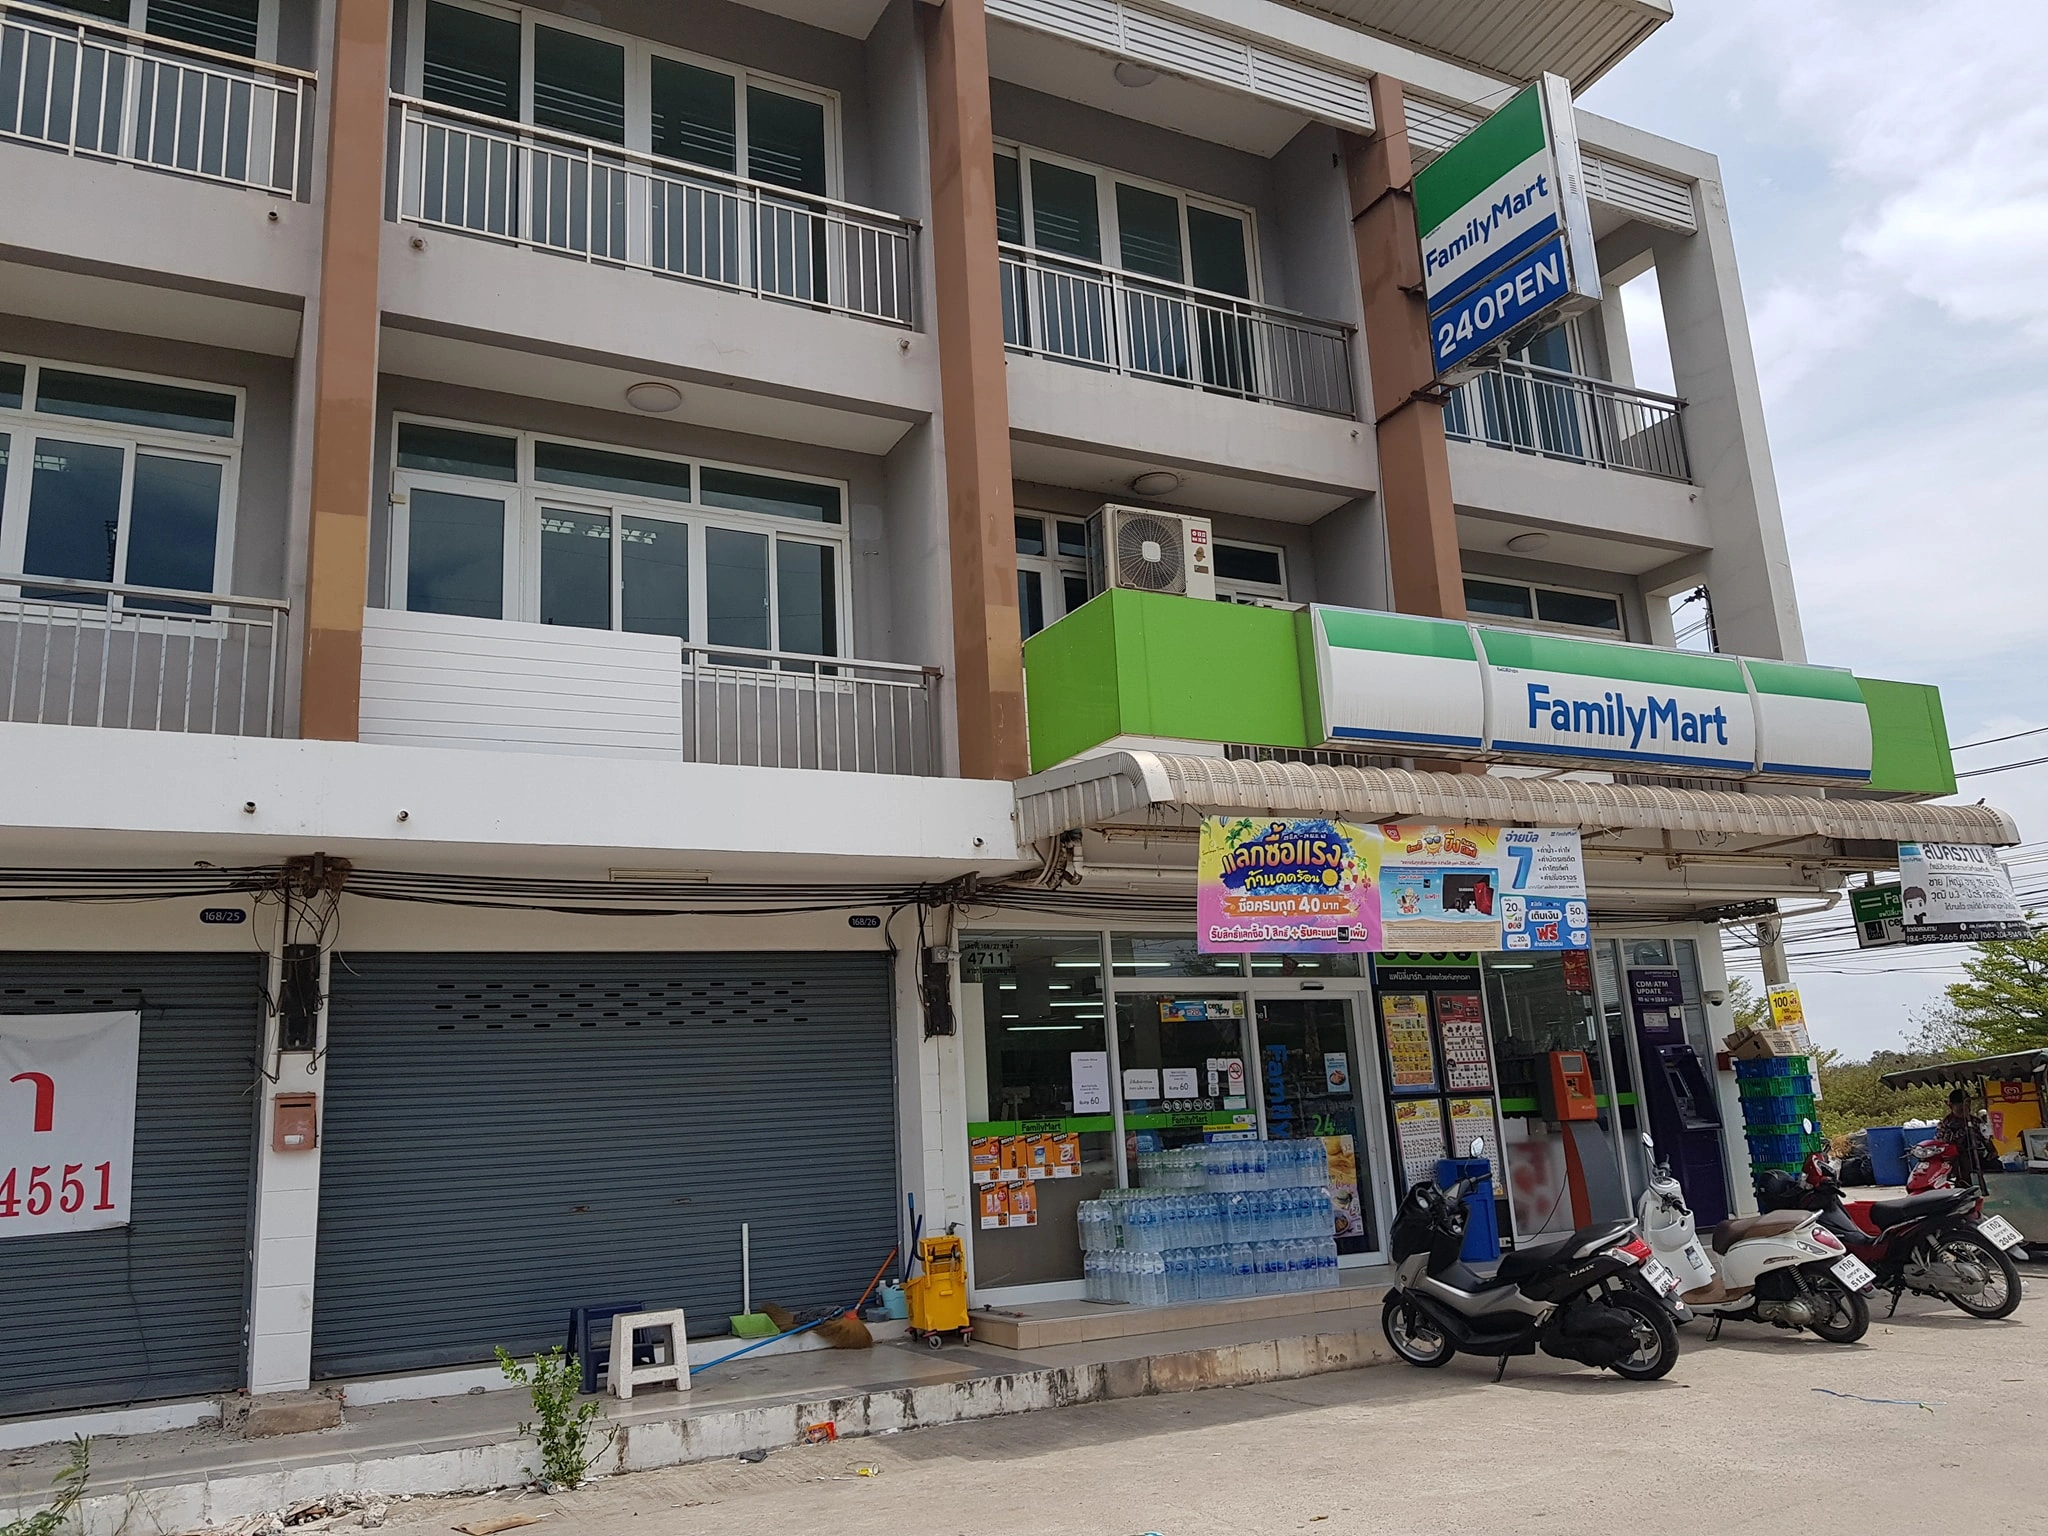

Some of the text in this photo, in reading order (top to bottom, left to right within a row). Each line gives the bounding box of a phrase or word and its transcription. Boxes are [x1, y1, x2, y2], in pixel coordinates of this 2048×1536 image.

[1425, 173, 1548, 278] FamilyMart
[1527, 683, 1729, 749] FamilyMart
[1443, 829, 1460, 853] ยิ่ง
[1505, 830, 1540, 842] จ่ายบิล
[1222, 822, 1342, 874] แลกซื้อแรง
[1922, 843, 1984, 864] สมครงาน
[1507, 845, 1534, 889] 7
[1928, 878, 1943, 887] ชาย
[1931, 889, 1947, 902] วุฒิ
[1298, 896, 1320, 913] 40
[1323, 902, 1340, 910] บาท
[1505, 902, 1518, 912] 20
[1569, 907, 1581, 915] 50
[204, 911, 242, 922] 168/25
[851, 917, 878, 927] 168/26
[1531, 911, 1559, 920] เติมเงิน
[1536, 922, 1558, 941] ฟรี
[967, 952, 1004, 965] 4711
[1773, 996, 1788, 1008] 100
[1179, 1082, 1189, 1091] 60
[1090, 1096, 1100, 1105] 60
[1171, 1114, 1208, 1125] FamilyMart
[1311, 1113, 1336, 1137] 24
[1021, 1122, 1061, 1134] FamilyMart
[1998, 1232, 2017, 1246] 2049
[1850, 1272, 1871, 1288] 5154
